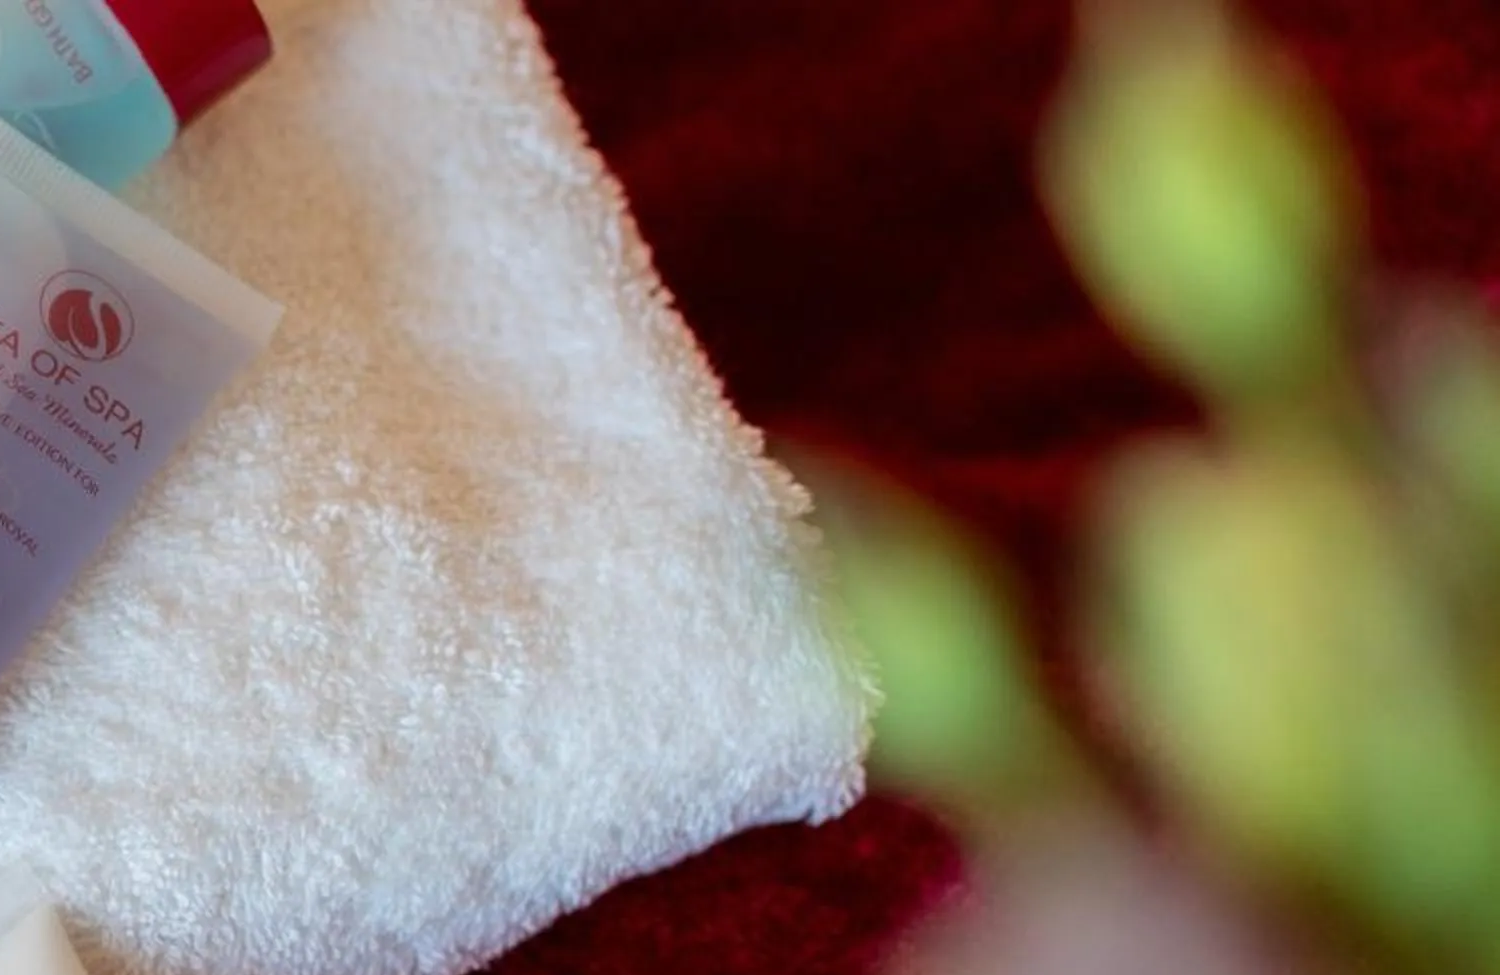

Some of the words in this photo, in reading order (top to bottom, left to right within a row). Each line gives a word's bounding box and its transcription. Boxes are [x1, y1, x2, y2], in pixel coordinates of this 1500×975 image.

[3, 373, 38, 401] Sea
[39, 395, 118, 465] Minerals
[30, 349, 82, 386] OF
[83, 385, 145, 451] SPA
[13, 423, 74, 473] EDITION
[71, 465, 99, 497] FOR
